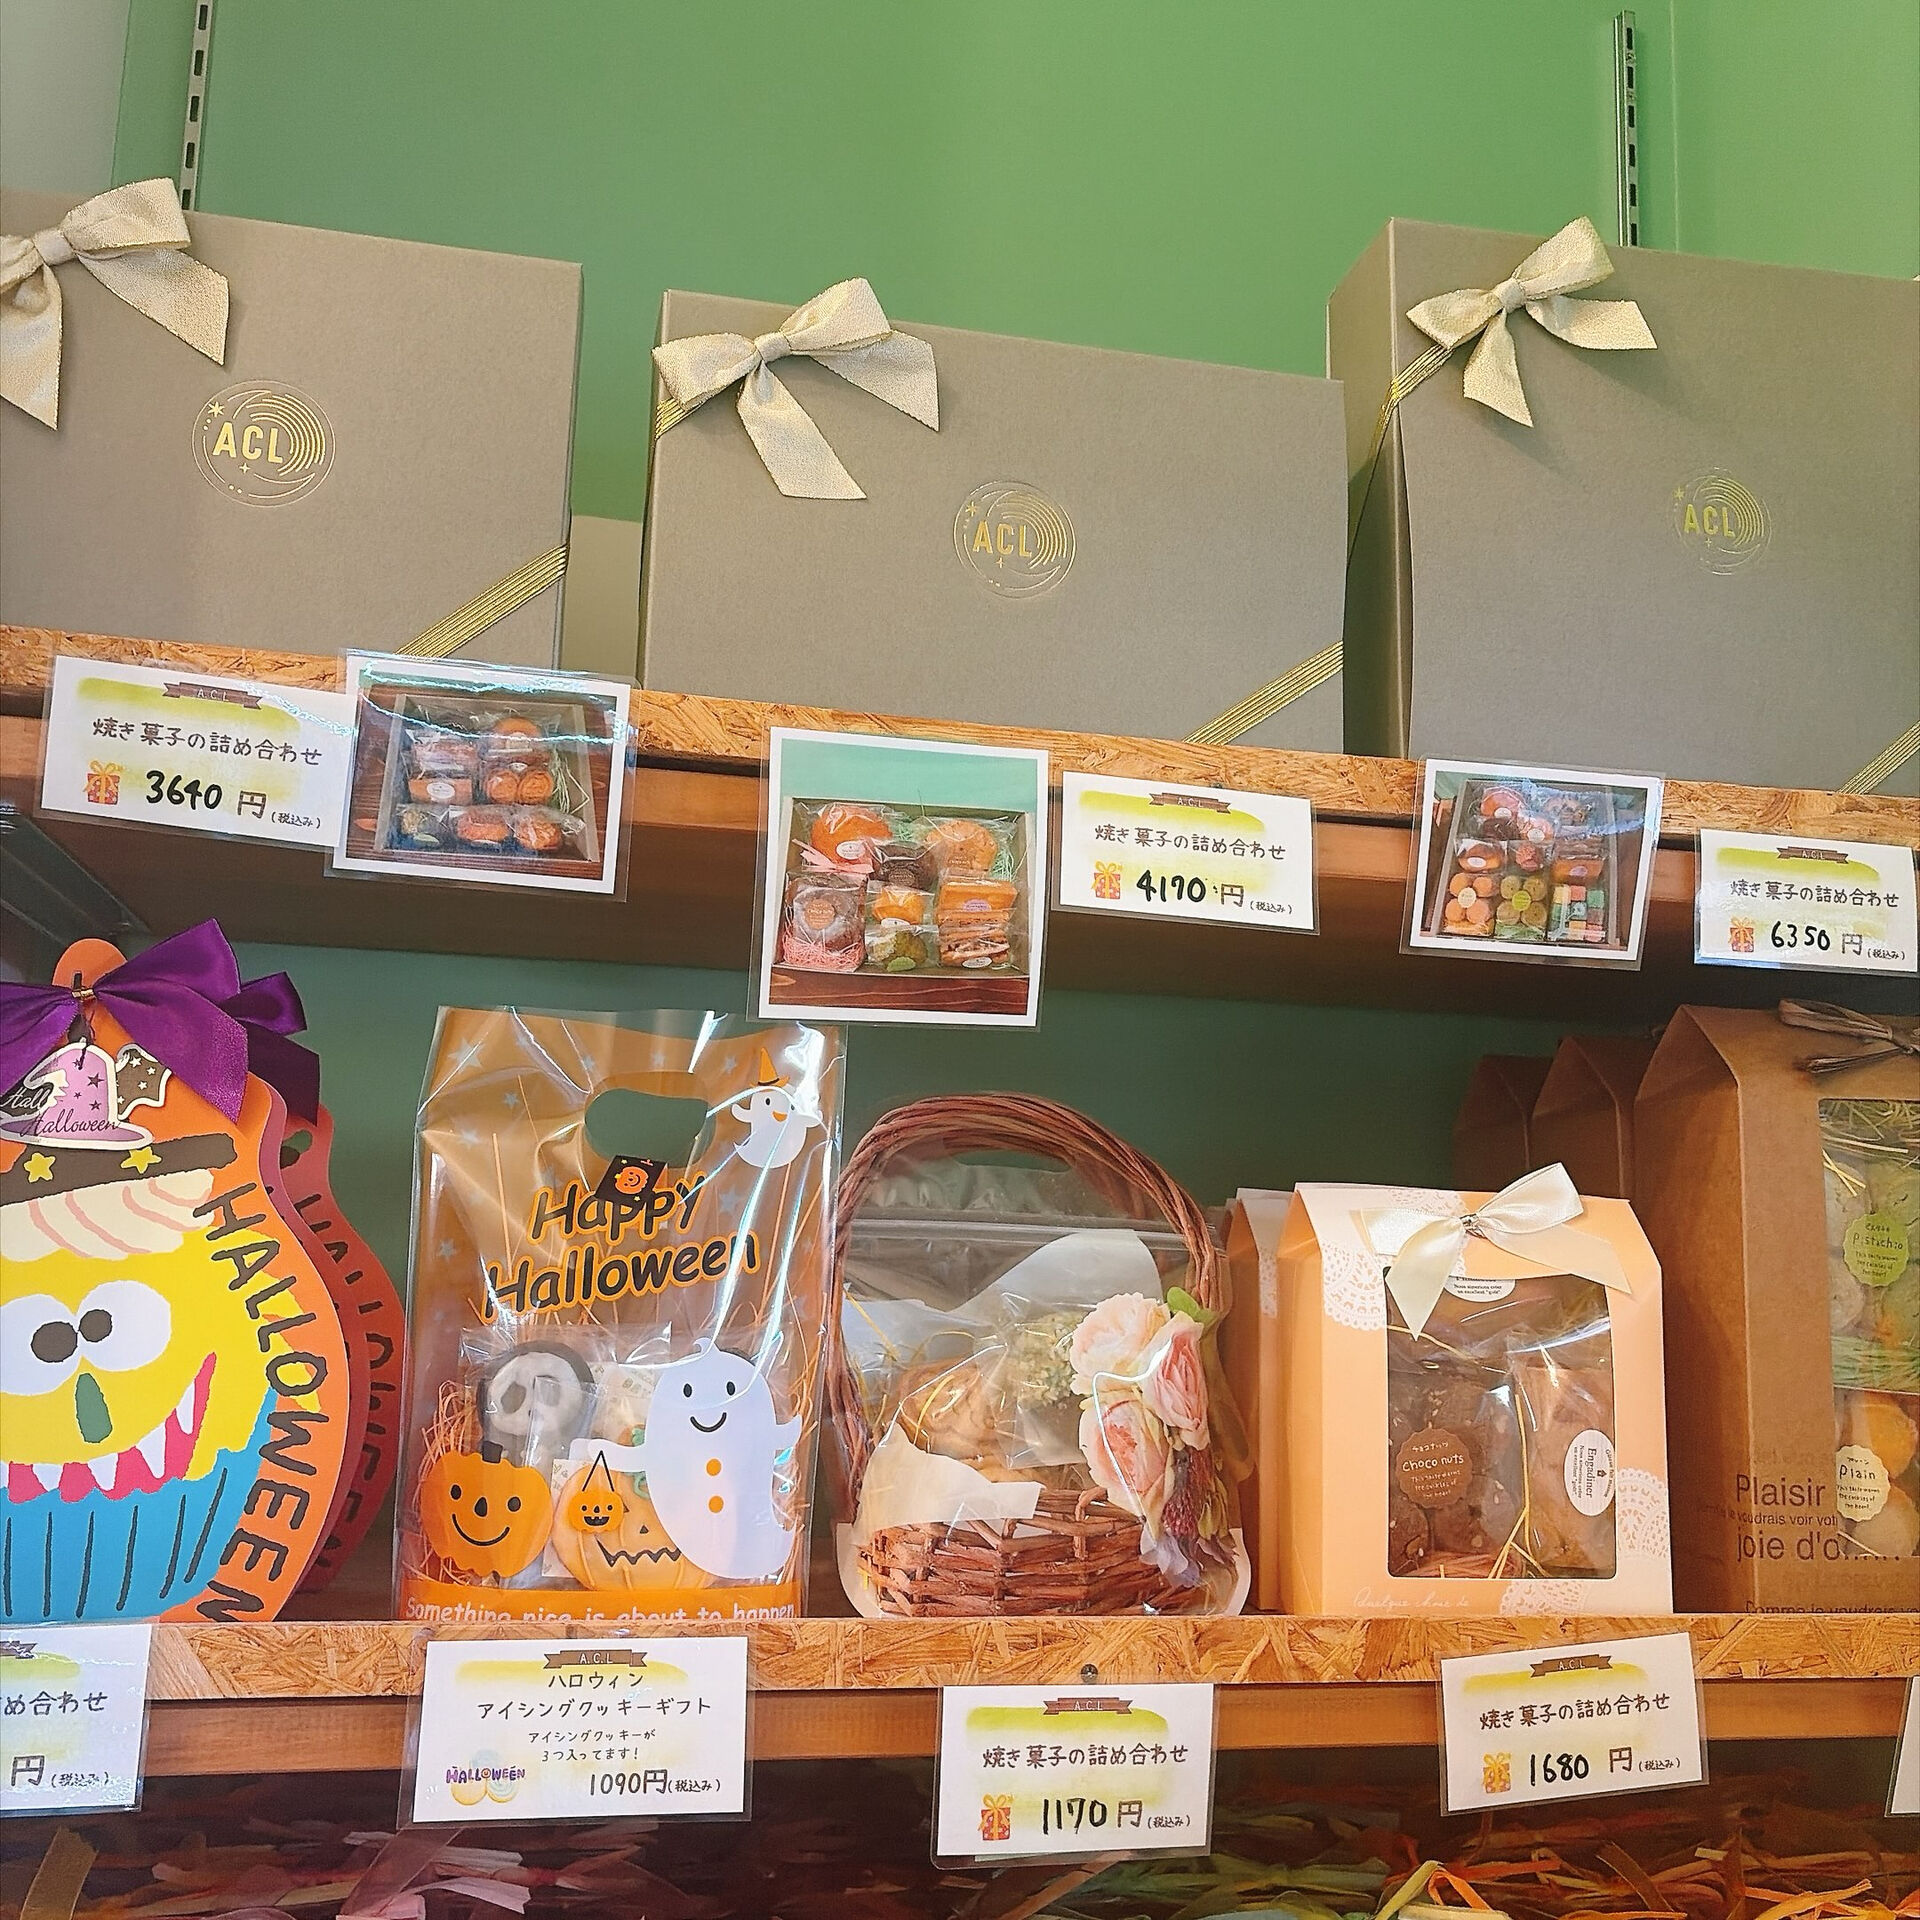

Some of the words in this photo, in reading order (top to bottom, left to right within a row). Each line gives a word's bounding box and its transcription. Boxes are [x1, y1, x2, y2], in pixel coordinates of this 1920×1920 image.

[212, 421, 283, 464] ACL
[1684, 504, 1736, 538] ACL
[972, 520, 1032, 558] ACL
[92, 716, 323, 766] 焼き菓子の詰め合わせ
[146, 770, 223, 810] 3640
[1095, 823, 1286, 860] 焼き菓子の詰め合わせ
[1136, 869, 1206, 903] 4170
[1730, 879, 1900, 907] 焼き菓子の詰め合わせ
[1771, 921, 1830, 951] 6350
[20, 1108, 119, 1137] Halloween
[530, 1175, 706, 1241] Happy
[483, 1234, 757, 1320] Halloween
[1441, 1454, 1464, 1465] nuts
[1585, 1447, 1597, 1498] Engadiner
[1839, 1464, 1876, 1480] Plain
[1736, 1474, 1826, 1507] Plaisir
[1736, 1510, 1786, 1526] voudrais
[1789, 1513, 1814, 1526] voir
[1737, 1528, 1785, 1563] joie
[548, 1671, 644, 1690] ハロウィン
[0, 1690, 109, 1716] め合わせ
[477, 1697, 711, 1720] アイシングクッキーギフト
[1479, 1693, 1670, 1730] 焼き菓子の詰め合わせ
[528, 1729, 656, 1743] アイシングクッキーが
[11, 1755, 45, 1786] 円
[982, 1743, 1189, 1769] 焼き菓子の詰め合わせ
[1529, 1753, 1590, 1787] 1680
[1043, 1797, 1108, 1835] 1170
